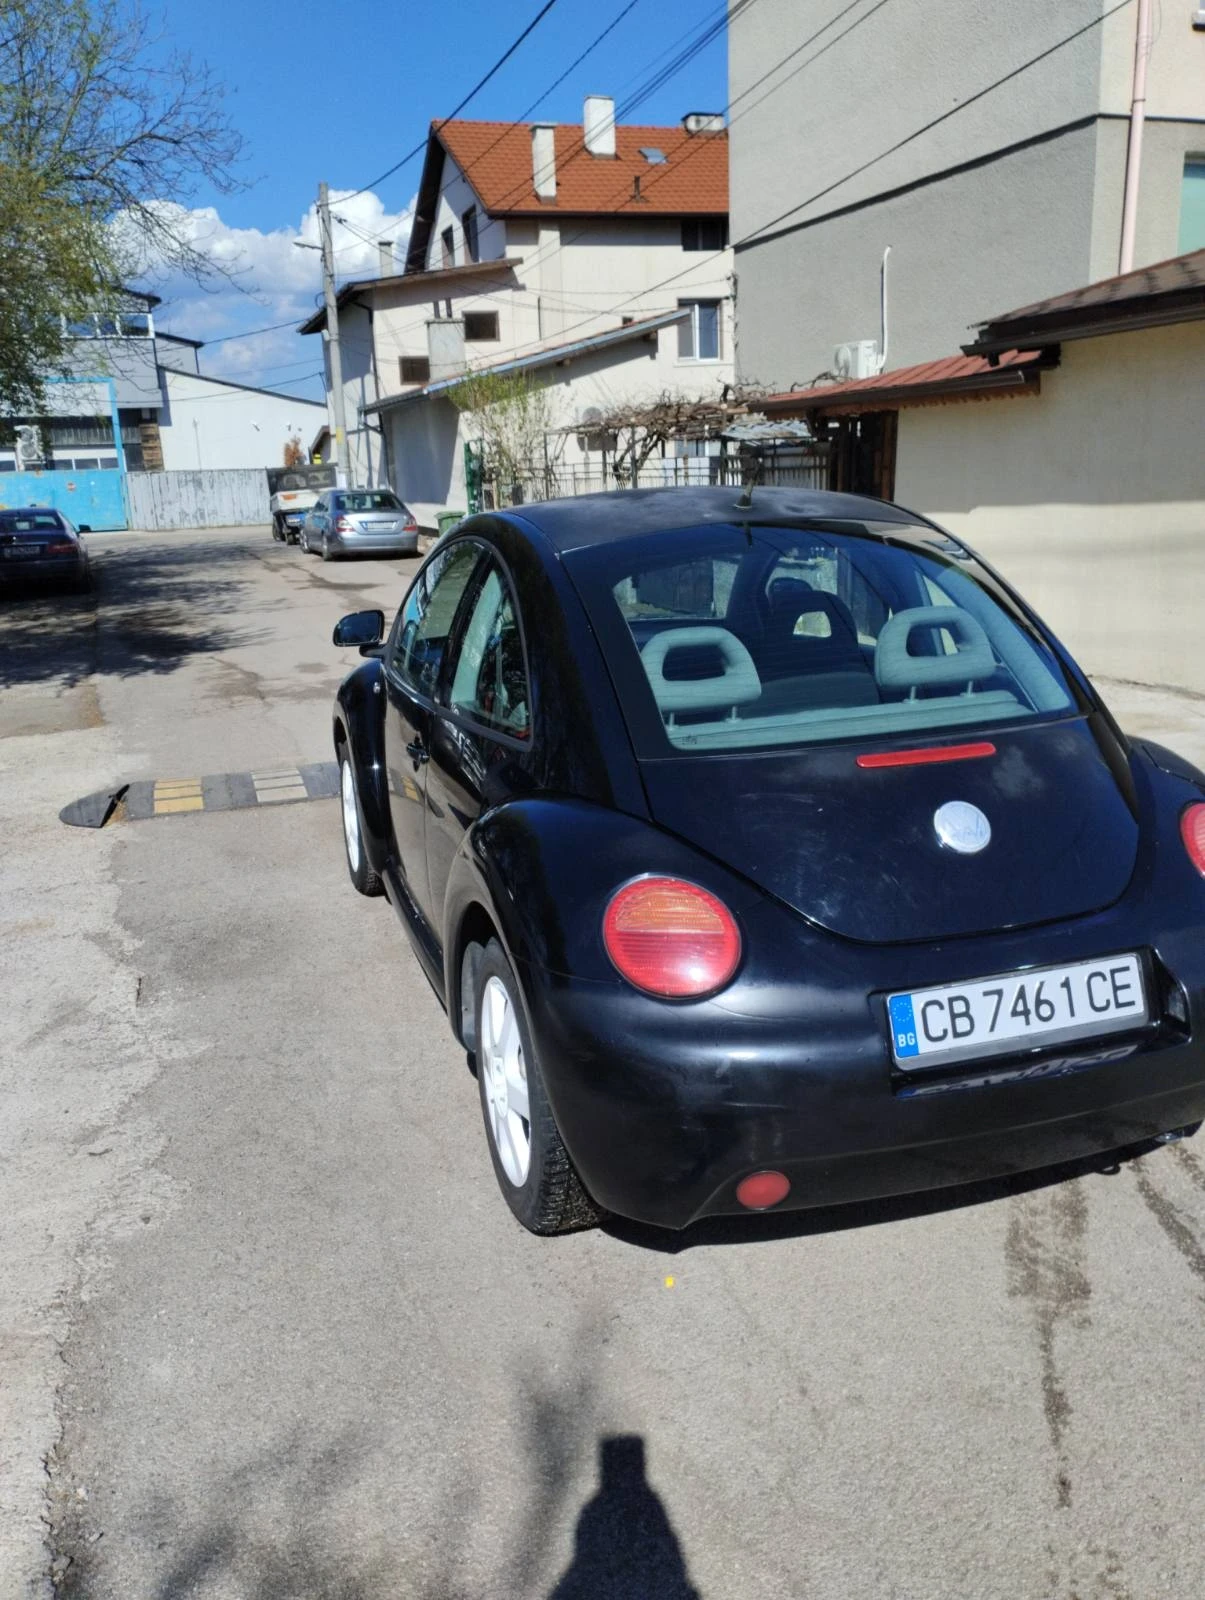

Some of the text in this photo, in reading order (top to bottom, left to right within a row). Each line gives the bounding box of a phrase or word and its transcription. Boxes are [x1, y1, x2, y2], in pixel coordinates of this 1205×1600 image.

[920, 965, 1136, 1042] CB 7461 CE
[897, 1032, 916, 1047] BG
